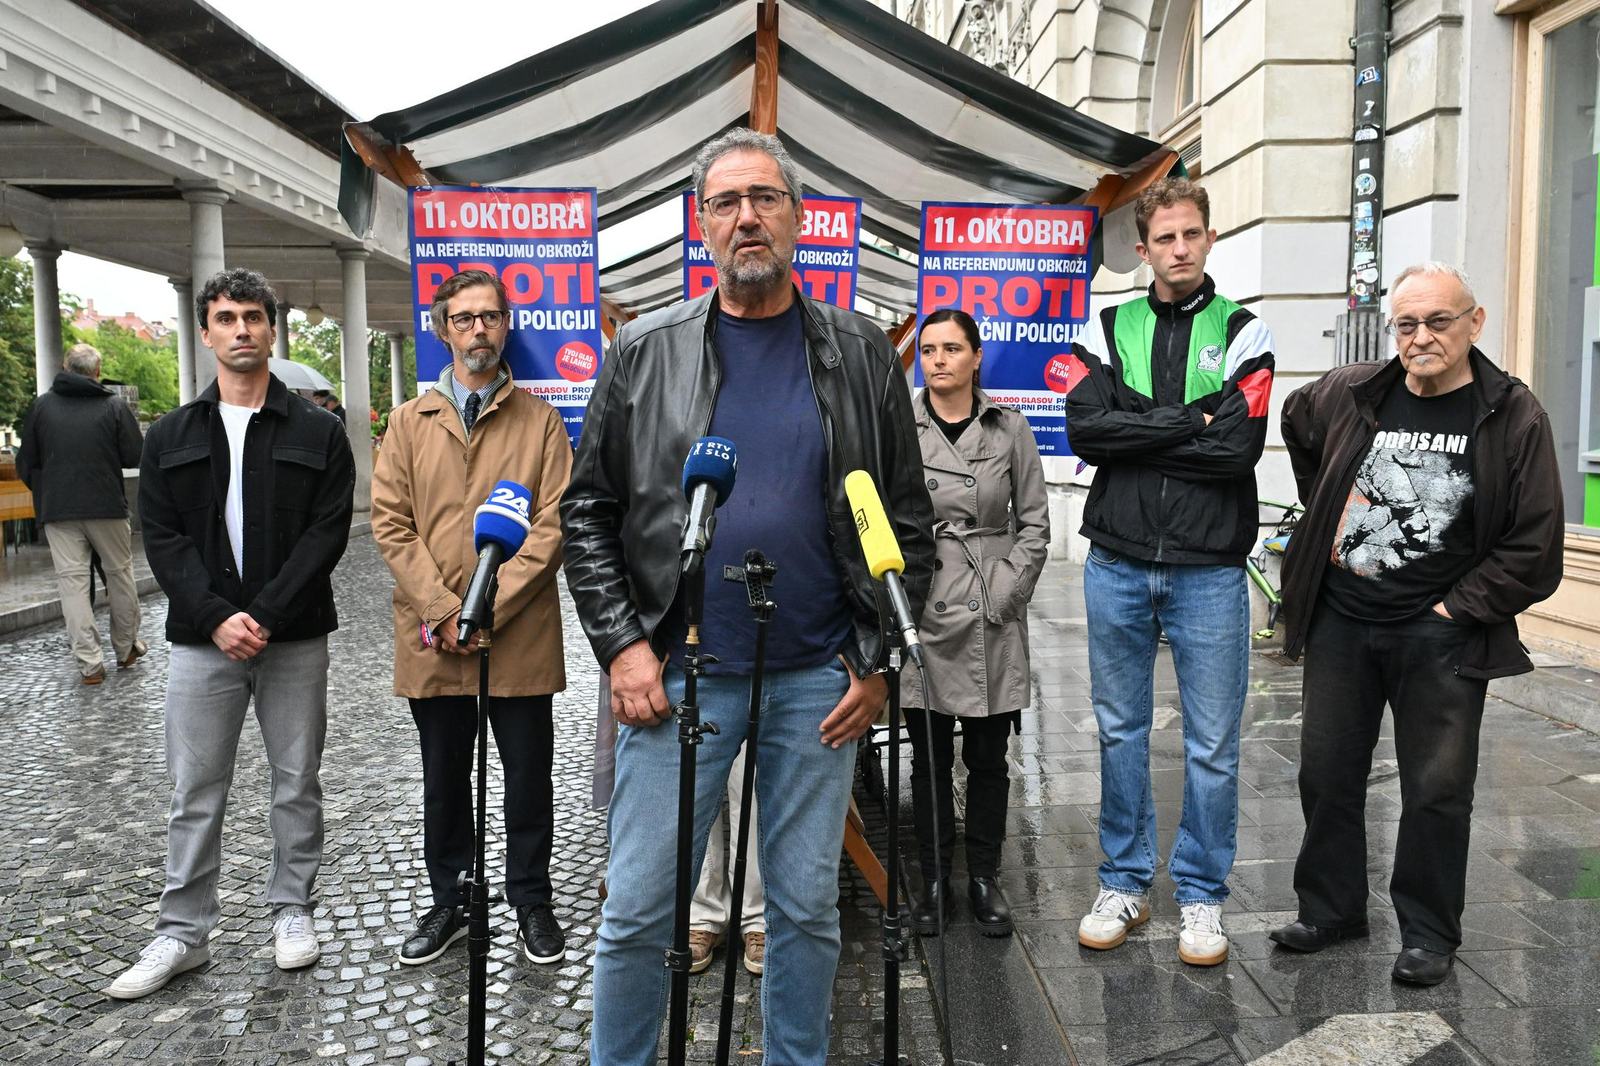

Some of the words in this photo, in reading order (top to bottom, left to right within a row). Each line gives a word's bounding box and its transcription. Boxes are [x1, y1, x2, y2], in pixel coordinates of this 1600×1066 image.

[460, 202, 586, 230] OKTOBRA
[967, 217, 1085, 246] OKTOBRA
[416, 243, 435, 257] NA
[437, 243, 534, 258] REFERENDUMU
[537, 240, 593, 258] OBKROŽI
[688, 246, 706, 261] NA
[799, 249, 853, 267] OBKROŽI
[923, 256, 941, 270] NA
[943, 257, 1035, 272] REFERENDUMU
[1037, 256, 1087, 273] OBKROŽI
[416, 263, 595, 304] POTI
[922, 275, 1086, 318] PROTI
[519, 309, 596, 331] POLICIJI
[562, 354, 570, 363] JE
[570, 357, 592, 369] LAHKO
[705, 448, 730, 460] SLO
[707, 441, 731, 452] RTV
[491, 487, 529, 514] 24
